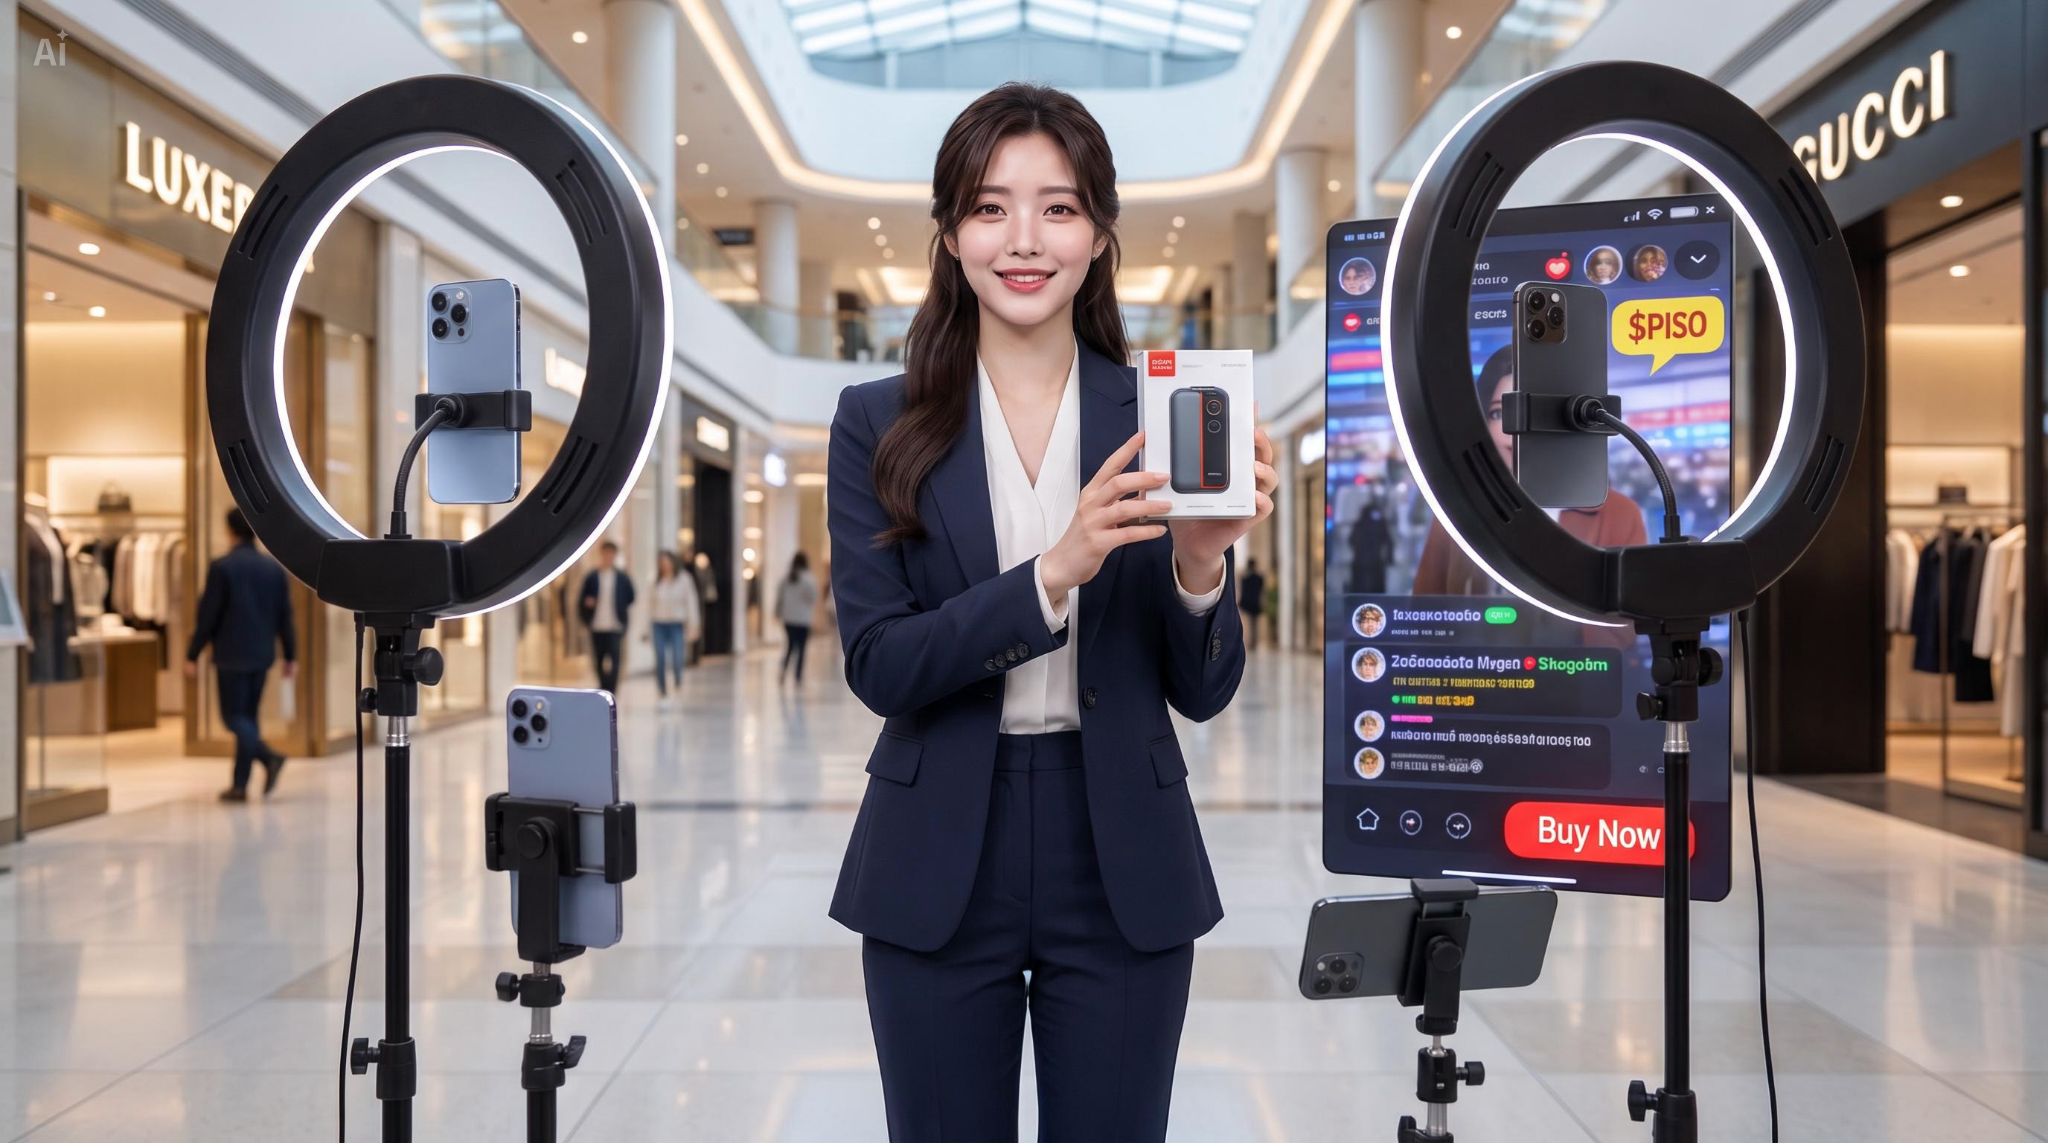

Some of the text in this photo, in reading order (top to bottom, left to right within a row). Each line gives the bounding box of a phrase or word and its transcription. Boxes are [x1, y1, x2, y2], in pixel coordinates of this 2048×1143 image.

[1793, 49, 1945, 183] GUCCI
[1628, 309, 1707, 345] $PISO
[1538, 816, 1661, 853] Buy Now
